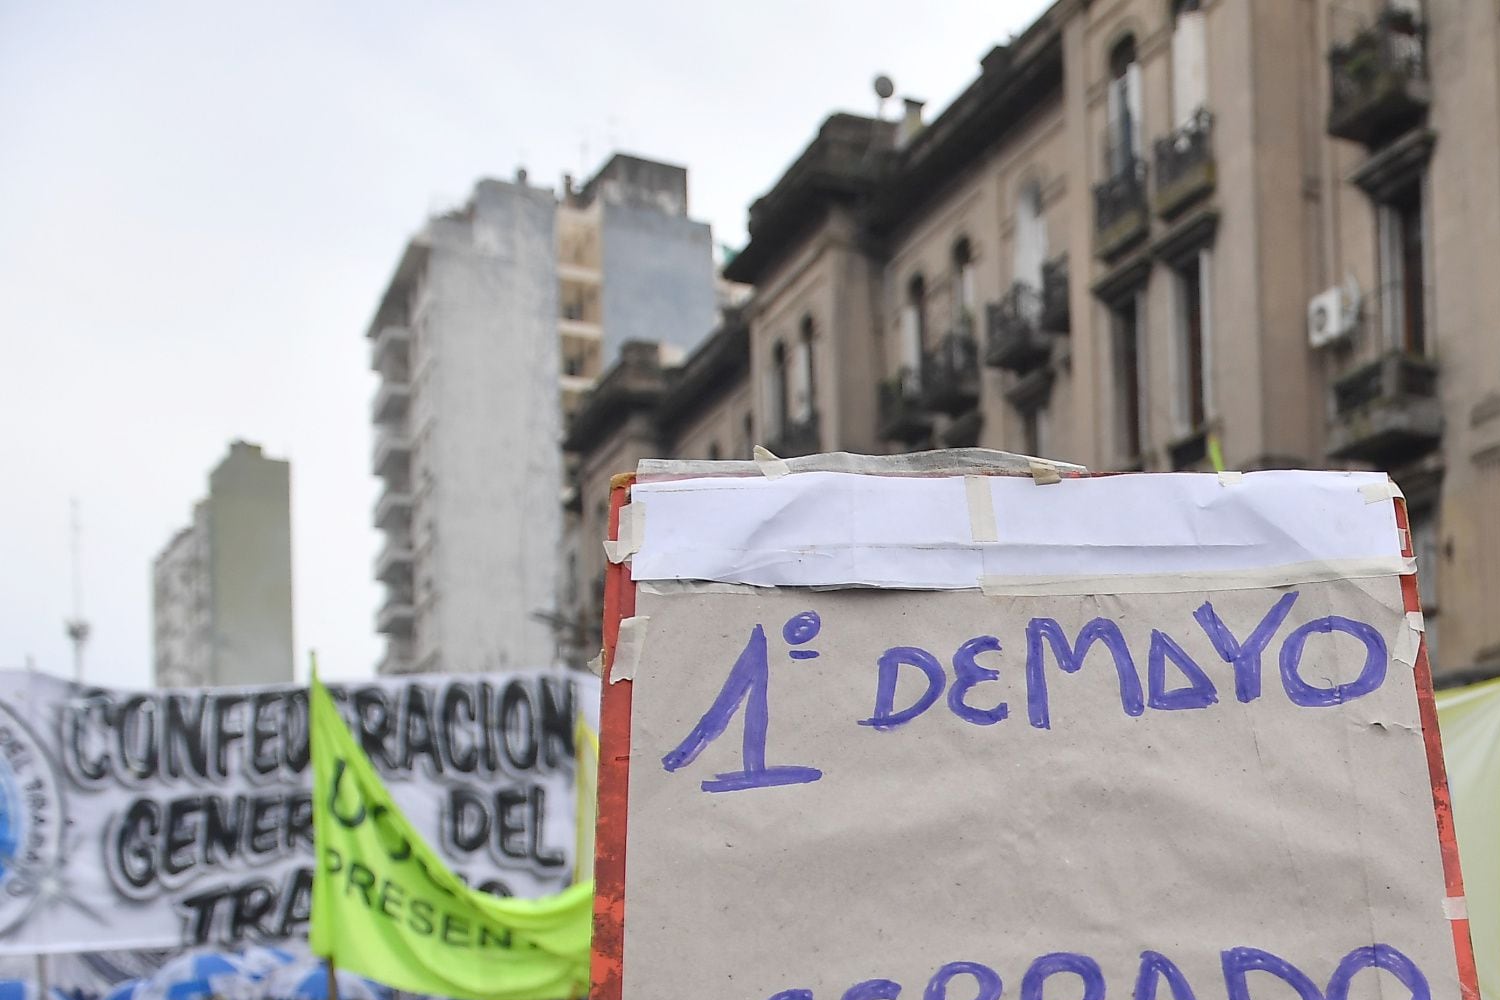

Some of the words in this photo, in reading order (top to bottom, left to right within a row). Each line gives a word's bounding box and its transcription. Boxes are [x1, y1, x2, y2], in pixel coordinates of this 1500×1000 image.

[857, 634, 1008, 733] DE
[1026, 590, 1390, 730] MAYO
[66, 674, 577, 782] CONFEDRACION
[450, 784, 566, 869] DEL
